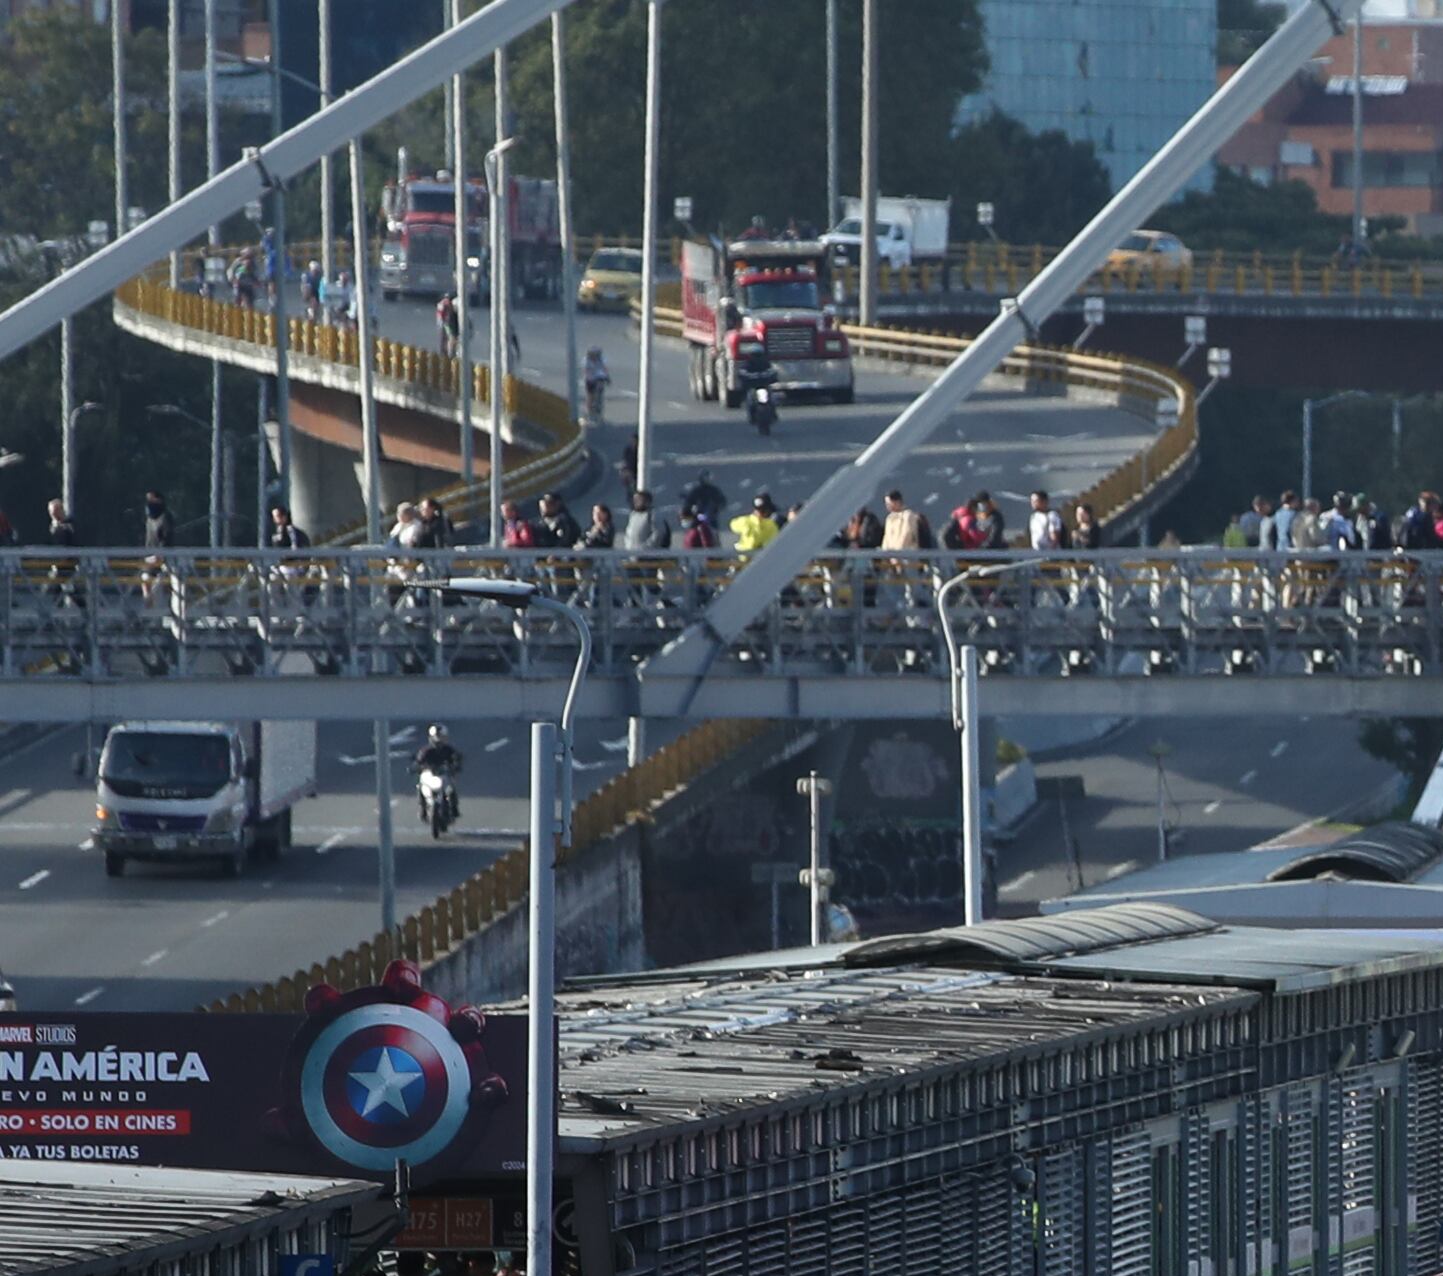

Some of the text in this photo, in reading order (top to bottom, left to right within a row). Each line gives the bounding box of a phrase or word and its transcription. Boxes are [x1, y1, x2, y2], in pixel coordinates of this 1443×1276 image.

[36, 1027, 76, 1041] STUDIOS
[29, 1045, 210, 1082] AMÉRICA
[62, 1090, 147, 1102] MUNDO
[40, 1115, 90, 1131] SOLO
[95, 1116, 119, 1130] EN
[124, 1115, 177, 1130] CINES
[9, 1145, 31, 1159] YA
[35, 1145, 66, 1159] TUS
[70, 1145, 140, 1160] BOLETAS
